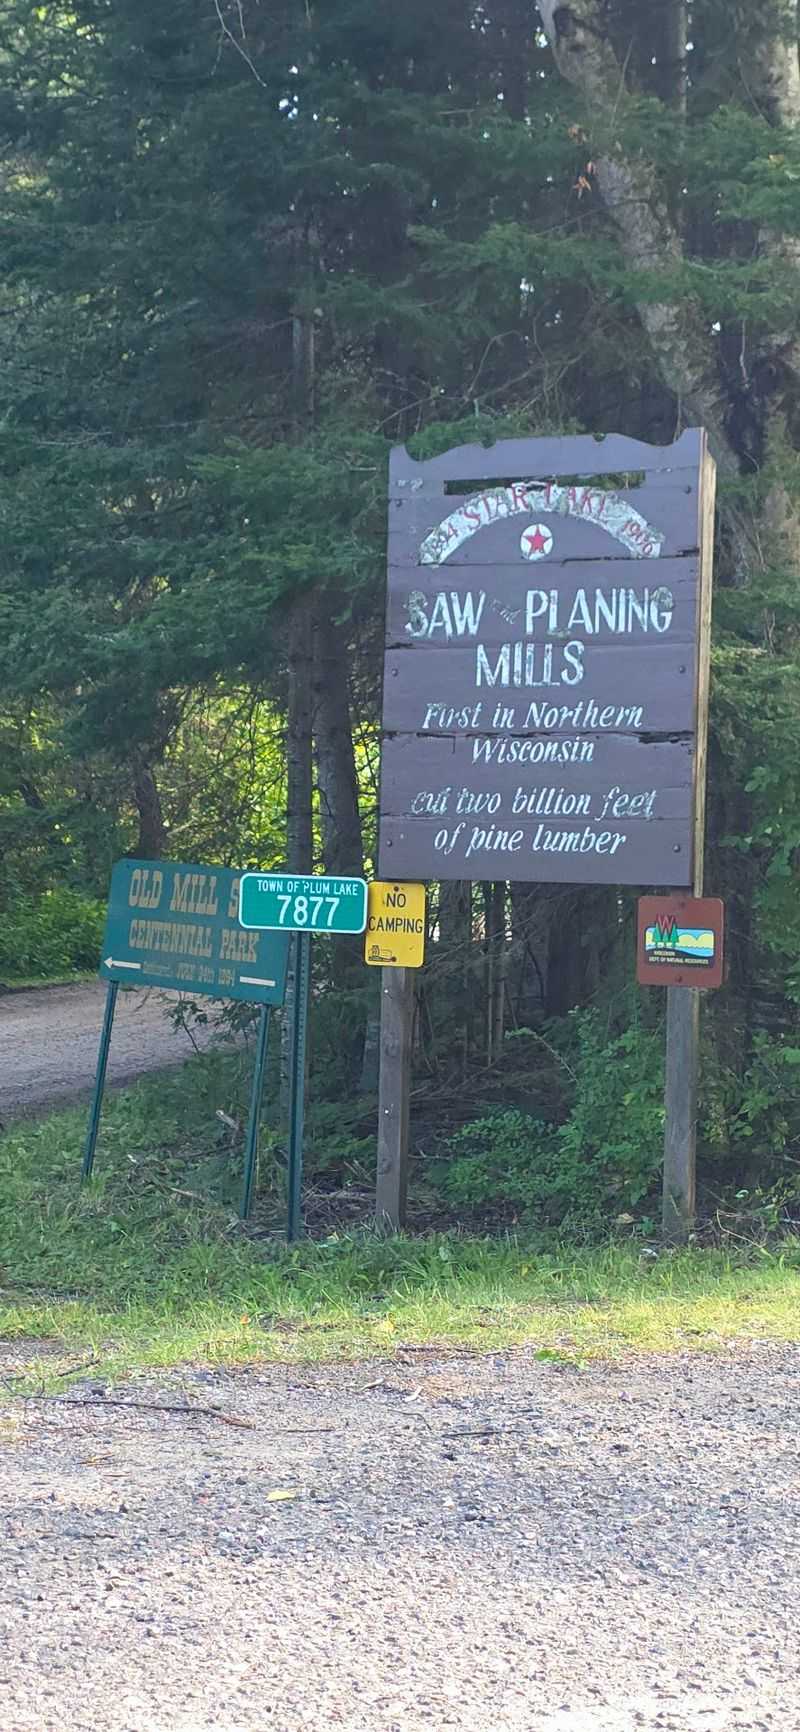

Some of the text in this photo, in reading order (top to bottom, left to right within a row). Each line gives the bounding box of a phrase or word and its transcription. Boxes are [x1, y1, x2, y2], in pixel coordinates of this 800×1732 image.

[404, 589, 486, 638] SAW
[526, 586, 673, 636] PLANING
[475, 640, 585, 688] MILLS
[422, 699, 643, 729] First in Northern
[472, 736, 594, 764] Wisconsin
[456, 787, 501, 814] two
[512, 787, 590, 815] billion
[594, 785, 657, 821] feet
[434, 822, 627, 857] of pine lumber
[128, 869, 163, 909] OLD
[170, 873, 217, 915] MILL
[257, 879, 358, 896] TOWN OF PLUM LAKE
[386, 893, 406, 908] NO
[277, 895, 340, 926] 7877
[368, 916, 423, 934] CAMPING
[128, 919, 260, 963] CENTENNIAL PARK
